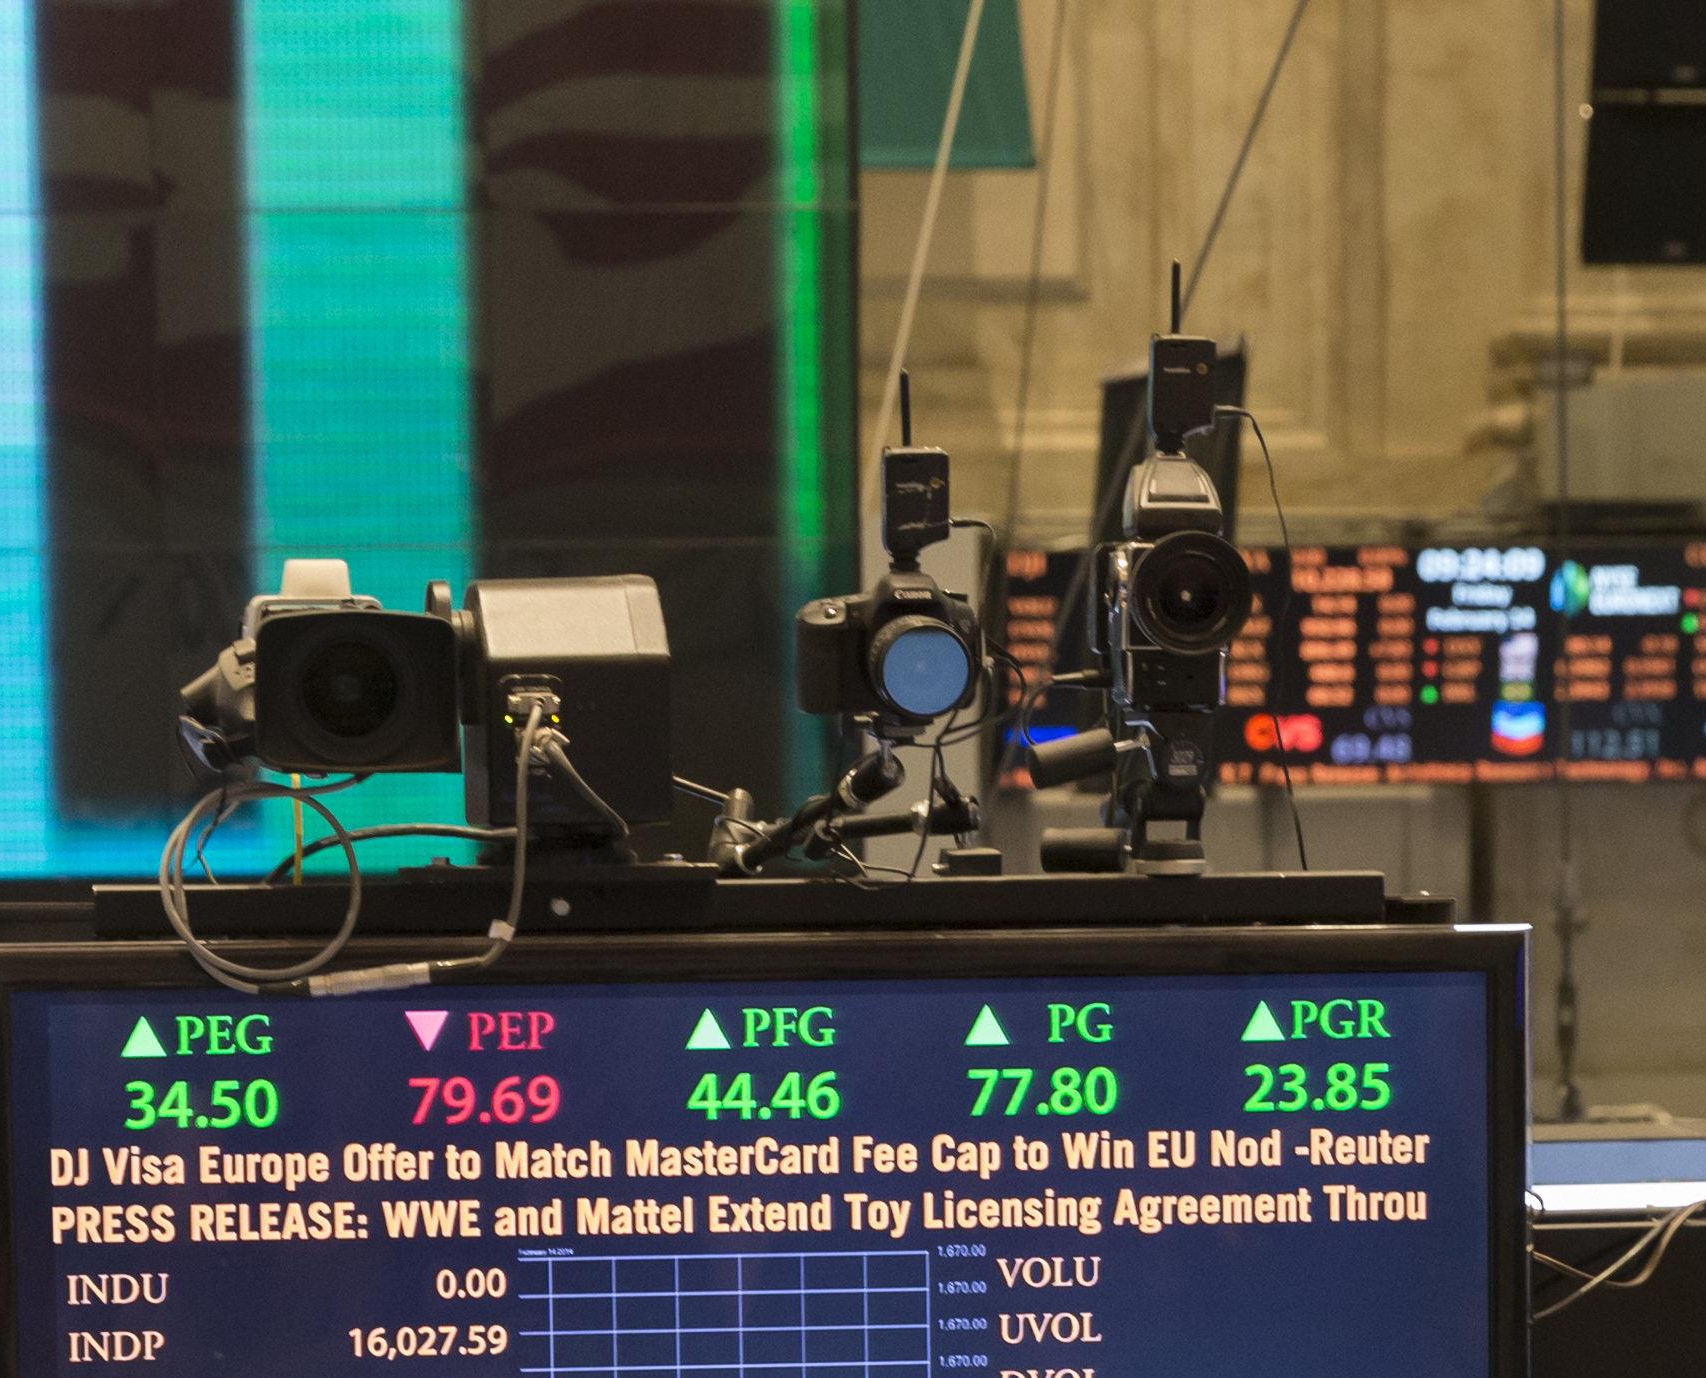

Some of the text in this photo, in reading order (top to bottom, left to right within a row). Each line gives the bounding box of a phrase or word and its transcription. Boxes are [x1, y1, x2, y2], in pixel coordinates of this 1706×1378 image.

[175, 1014, 274, 1056] PEG
[468, 1011, 555, 1051] PEP
[741, 1006, 836, 1048] PFG
[1047, 1002, 1114, 1043] PG
[1290, 998, 1391, 1039] PGR
[124, 1078, 279, 1130] 34.50
[408, 1074, 561, 1125] 79.69
[687, 1070, 841, 1121] 44.46
[967, 1066, 1118, 1117] 77.80
[1243, 1062, 1391, 1112] 23.85
[50, 1127, 1431, 1192] DJ Visa Europe Offer to Match MasterCard Fee Cap to Win EU Nod -Reuter
[51, 1184, 1427, 1245] PRESS RELEASE: WWE and Mattel Extend Toy Licensing Agreement Throu
[937, 1244, 987, 1258] 1,670.00
[66, 1267, 507, 1306] INDU 0.00
[937, 1281, 987, 1295] 1,670.00
[996, 1256, 1102, 1288] VOLU
[68, 1324, 508, 1363] INDP 16,027.59
[937, 1318, 987, 1332] 1,670.00
[998, 1312, 1103, 1345] UVOL
[937, 1354, 987, 1369] 1,670.00
